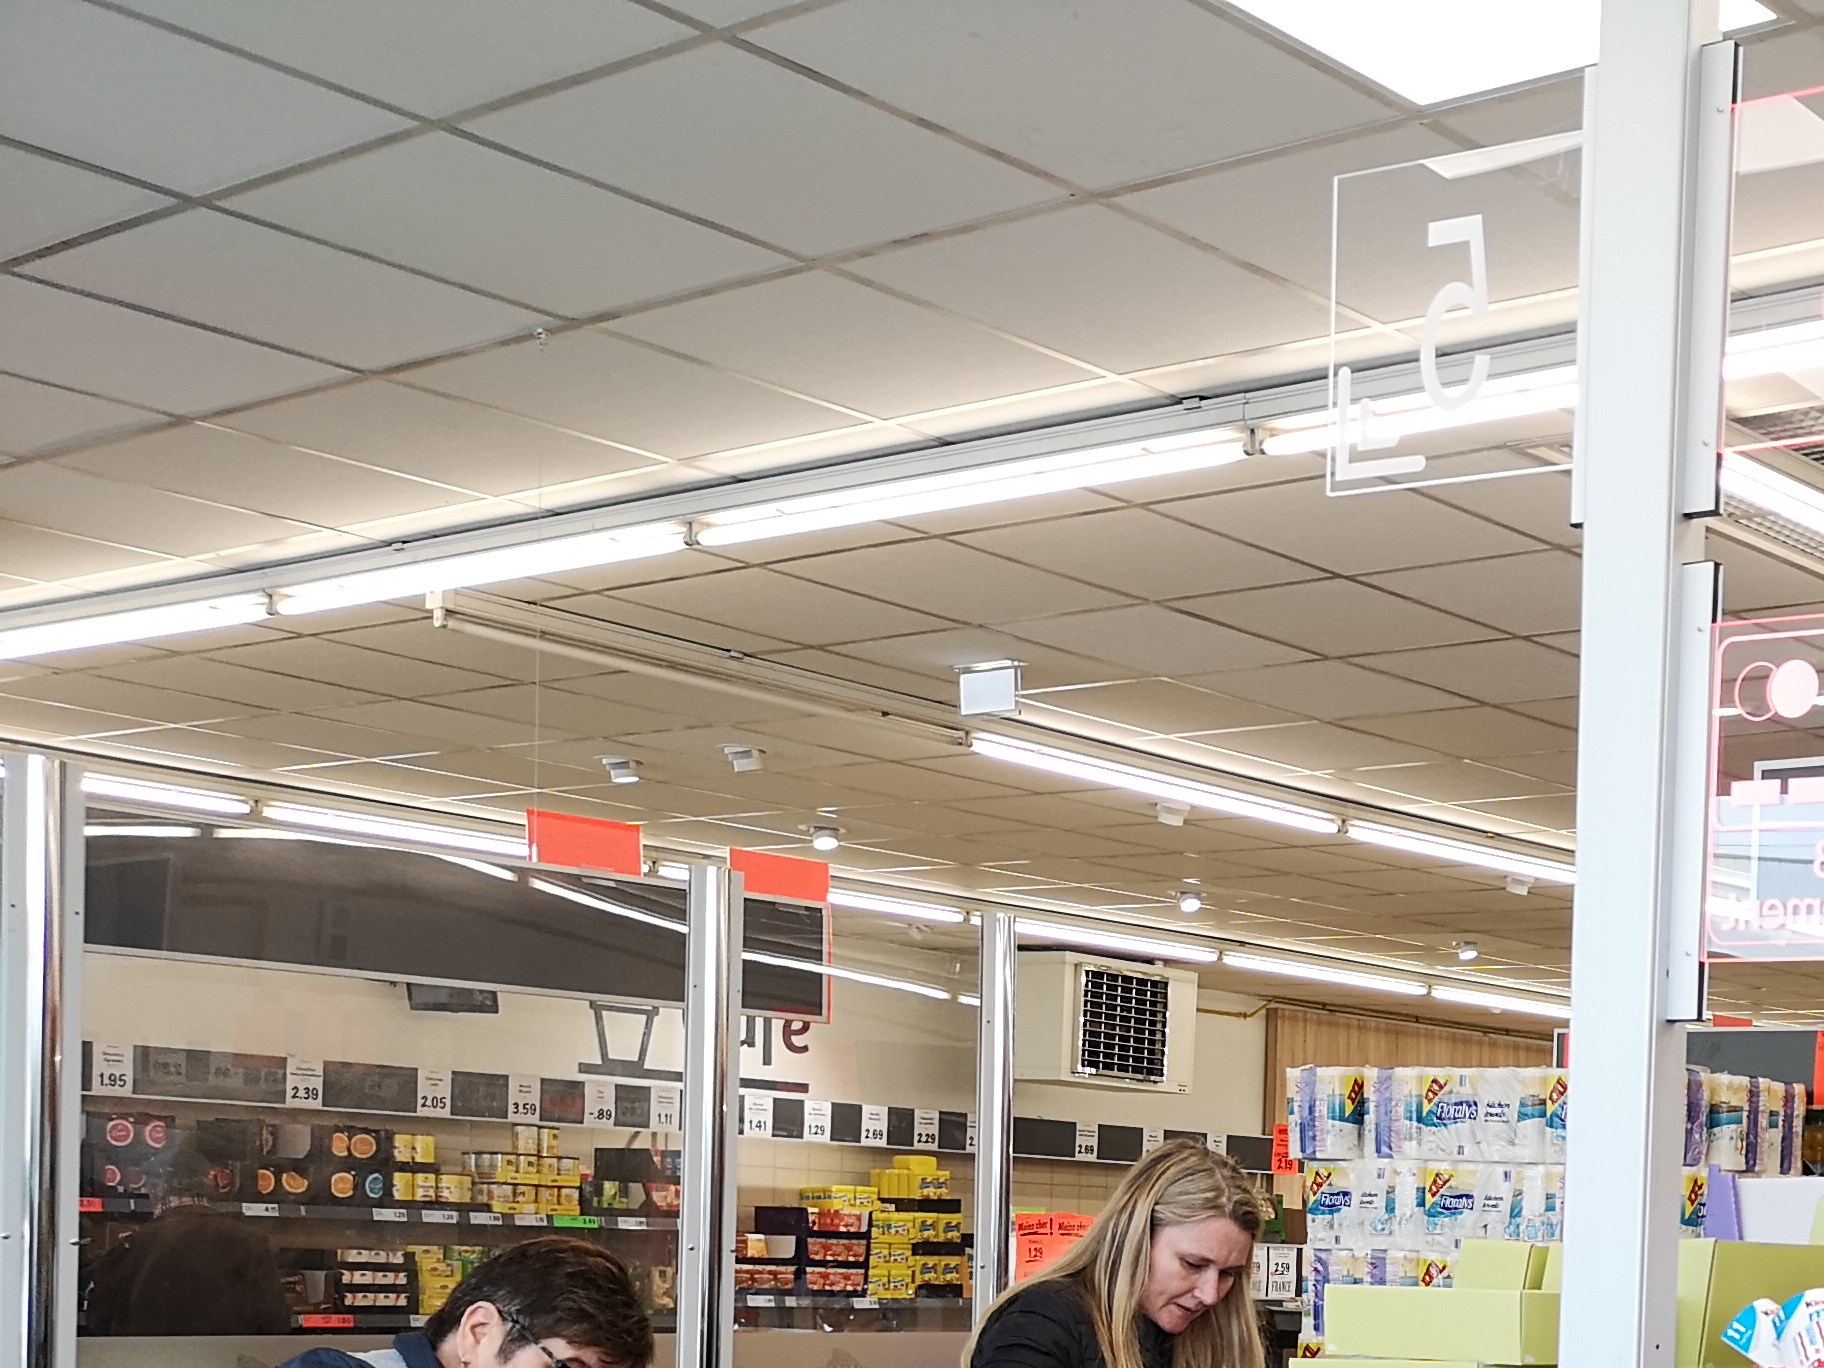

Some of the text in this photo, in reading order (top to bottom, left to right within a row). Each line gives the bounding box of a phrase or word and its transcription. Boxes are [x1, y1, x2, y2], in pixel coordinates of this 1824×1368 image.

[98, 1072, 127, 1088] 1.95
[290, 1085, 319, 1101] 2.39
[420, 1096, 447, 1110] 2.05
[512, 1102, 537, 1116] 3.59
[588, 1108, 612, 1121] -.89
[1436, 1101, 1478, 1122] Floralys
[748, 1119, 768, 1132] 1.41
[808, 1124, 825, 1136] 1.29
[865, 1128, 884, 1141] 2.69
[917, 1133, 936, 1144] 2.29
[1320, 1192, 1351, 1207] Floralys
[1440, 1194, 1474, 1209] Floralys
[1028, 1247, 1044, 1259] 1.29
[1274, 1262, 1290, 1275] 2.59
[1271, 1281, 1292, 1293] FRANCE
